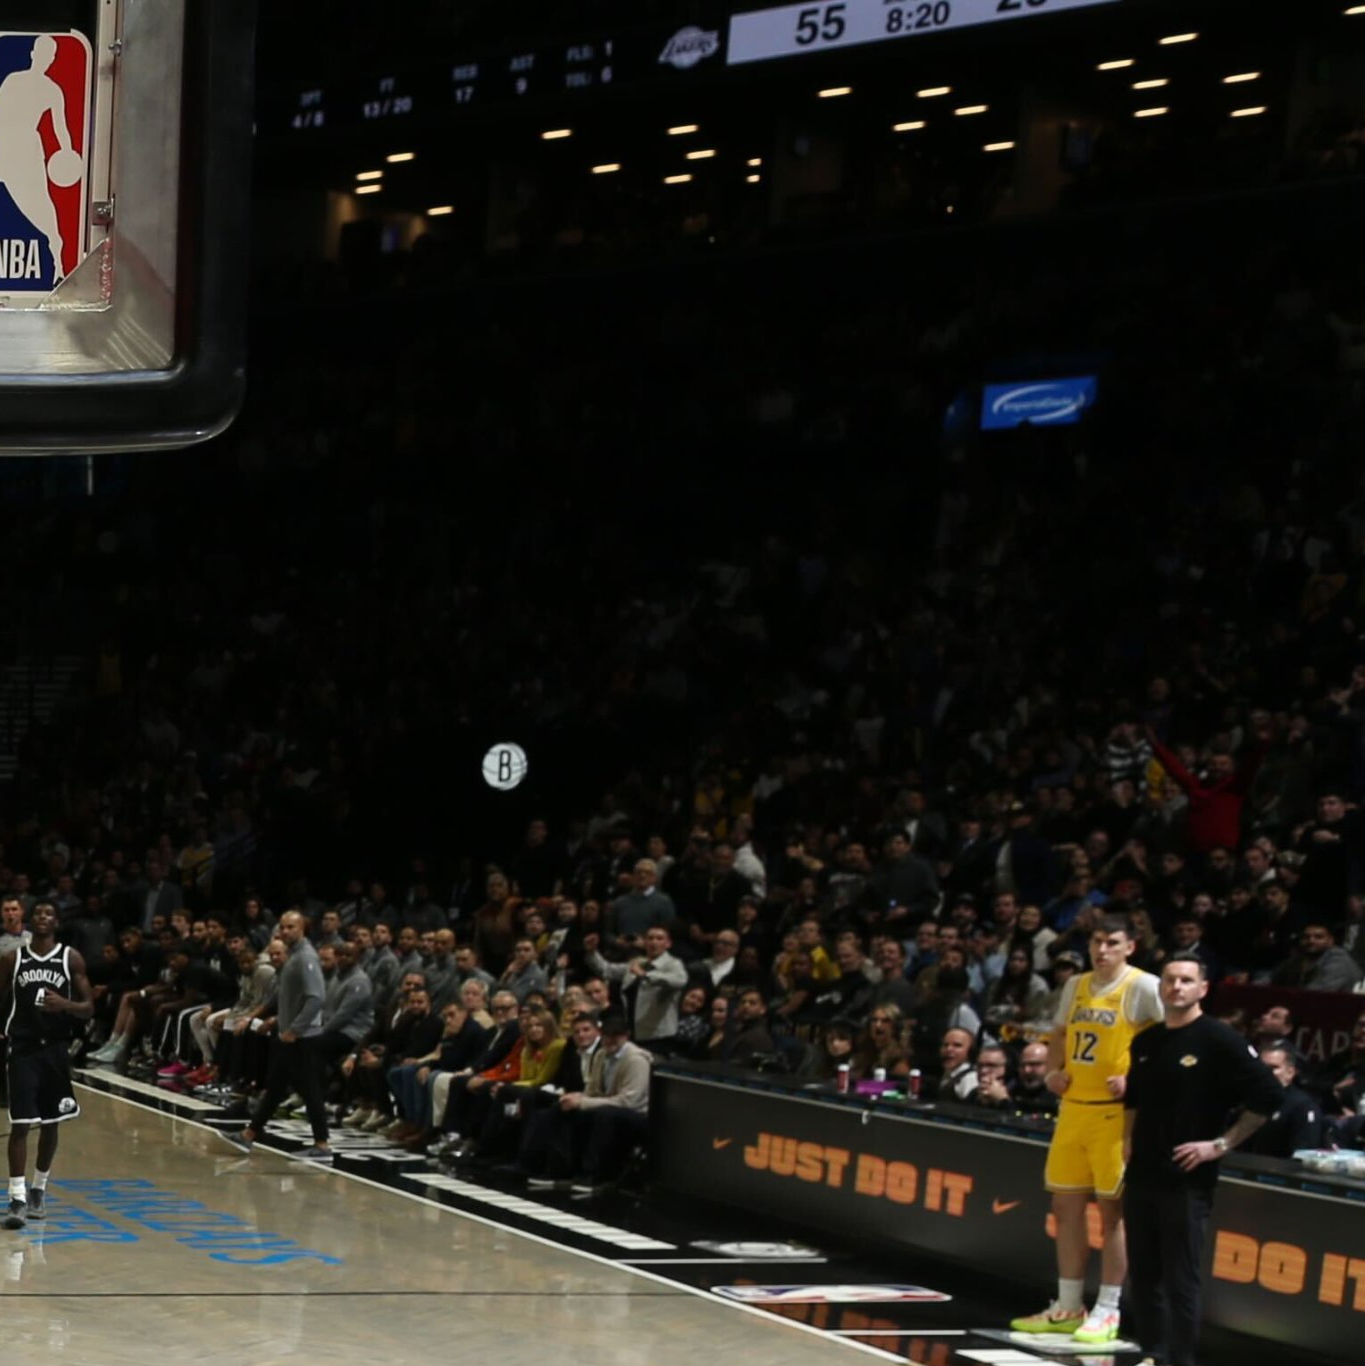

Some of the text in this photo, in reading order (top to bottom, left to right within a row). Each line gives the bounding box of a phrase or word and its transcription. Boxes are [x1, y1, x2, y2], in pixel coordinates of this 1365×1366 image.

[795, 6, 846, 45] 55
[885, 1, 950, 33] 8:20
[17, 968, 67, 989] BROOKLYN
[1072, 1031, 1098, 1062] 12
[743, 1132, 974, 1217] JUST DO IT
[1212, 1230, 1307, 1295] DO
